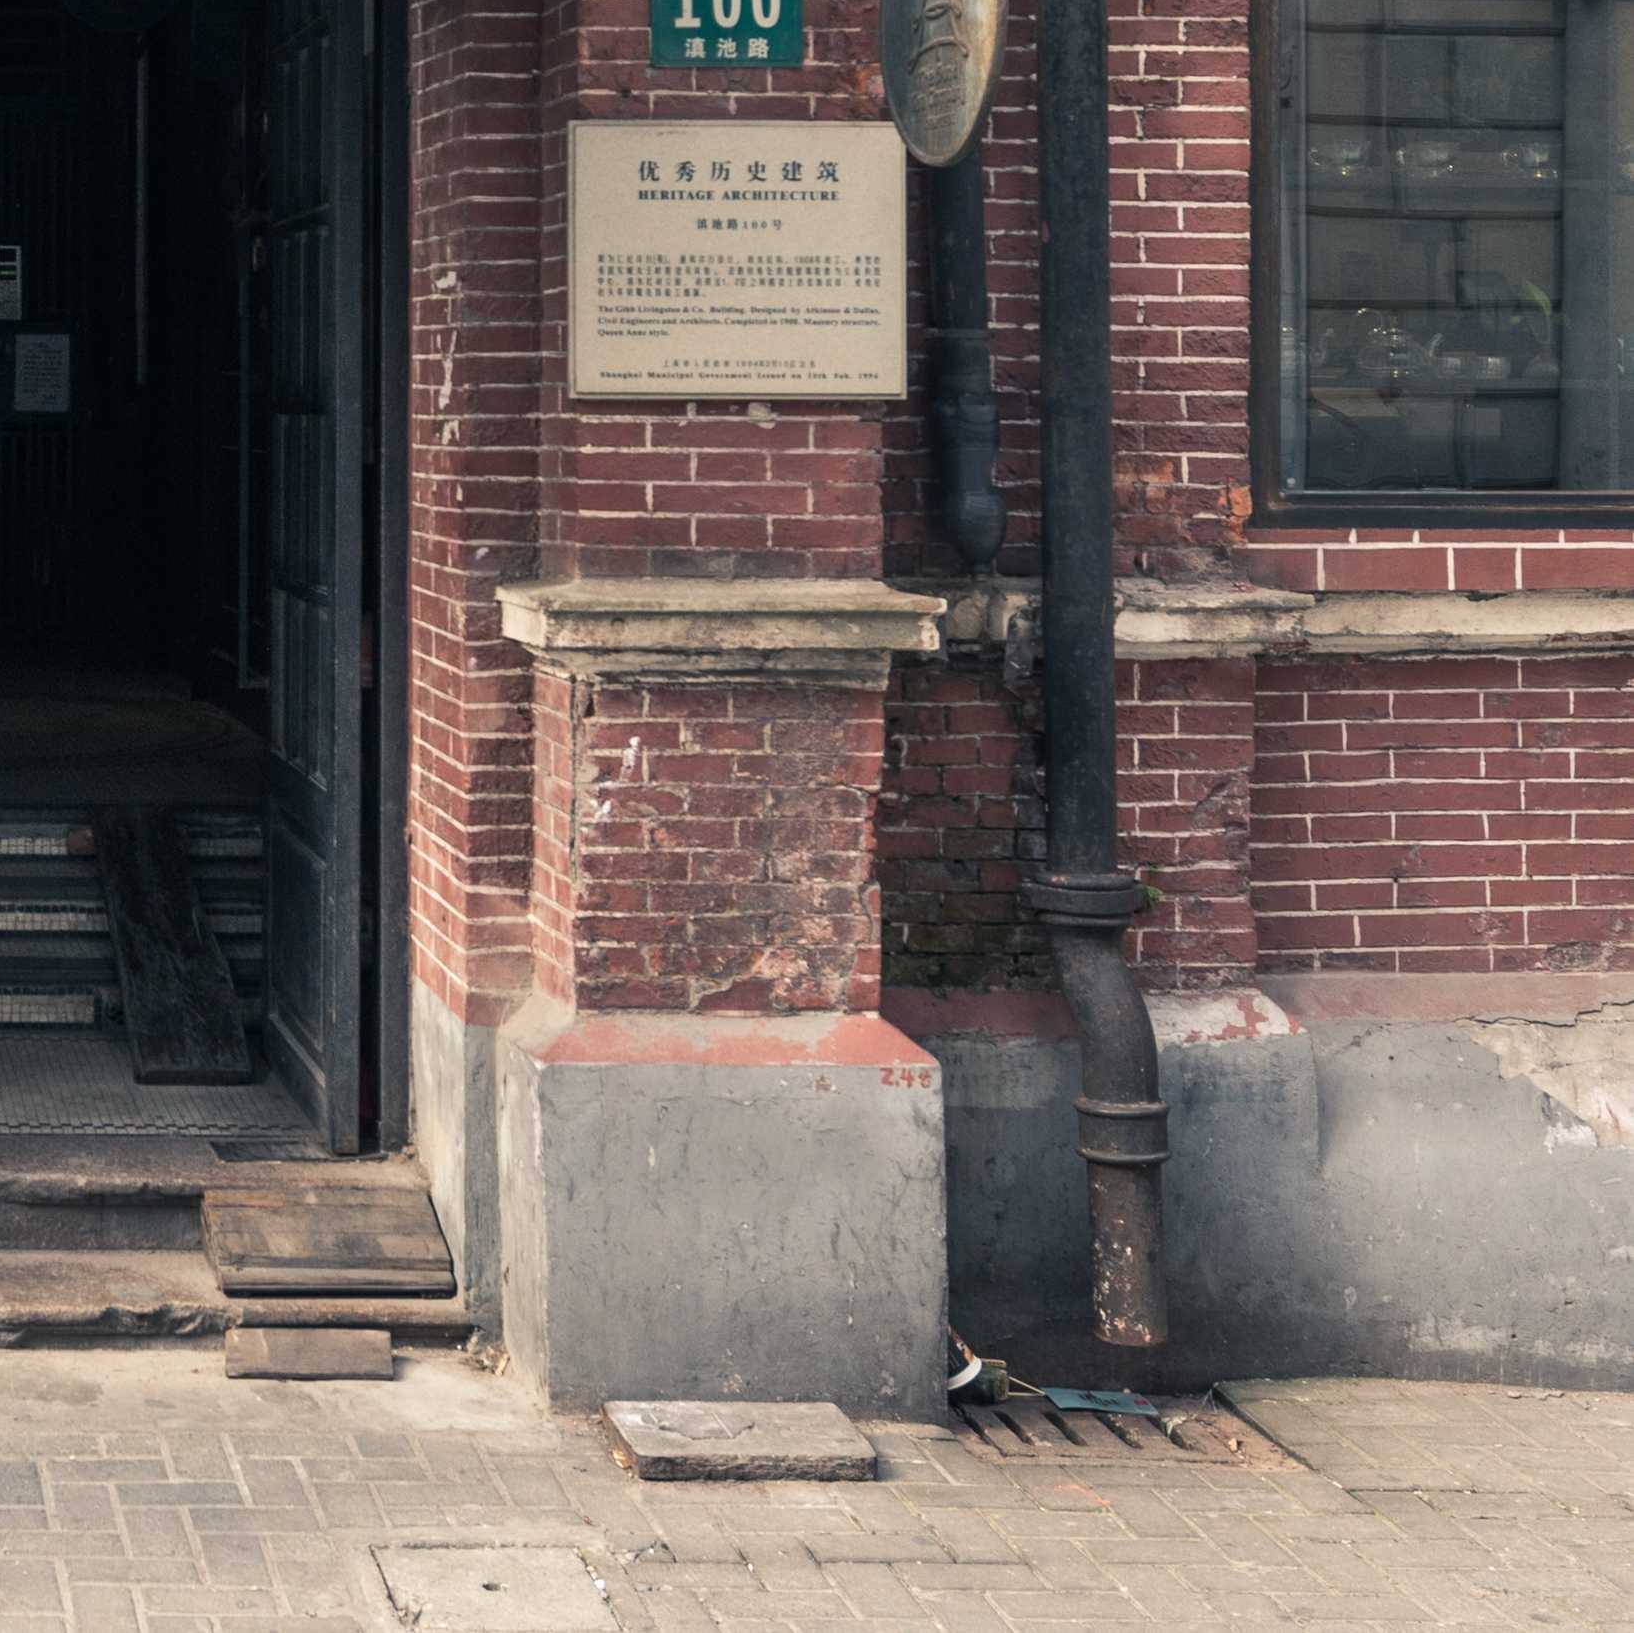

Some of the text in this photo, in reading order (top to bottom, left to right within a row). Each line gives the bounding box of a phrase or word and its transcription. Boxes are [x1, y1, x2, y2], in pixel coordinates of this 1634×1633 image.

[684, 37, 770, 59] 滇池路
[637, 160, 840, 183] 优秀历史建筑
[637, 189, 840, 202] HERITAGE ARCHITECTURE
